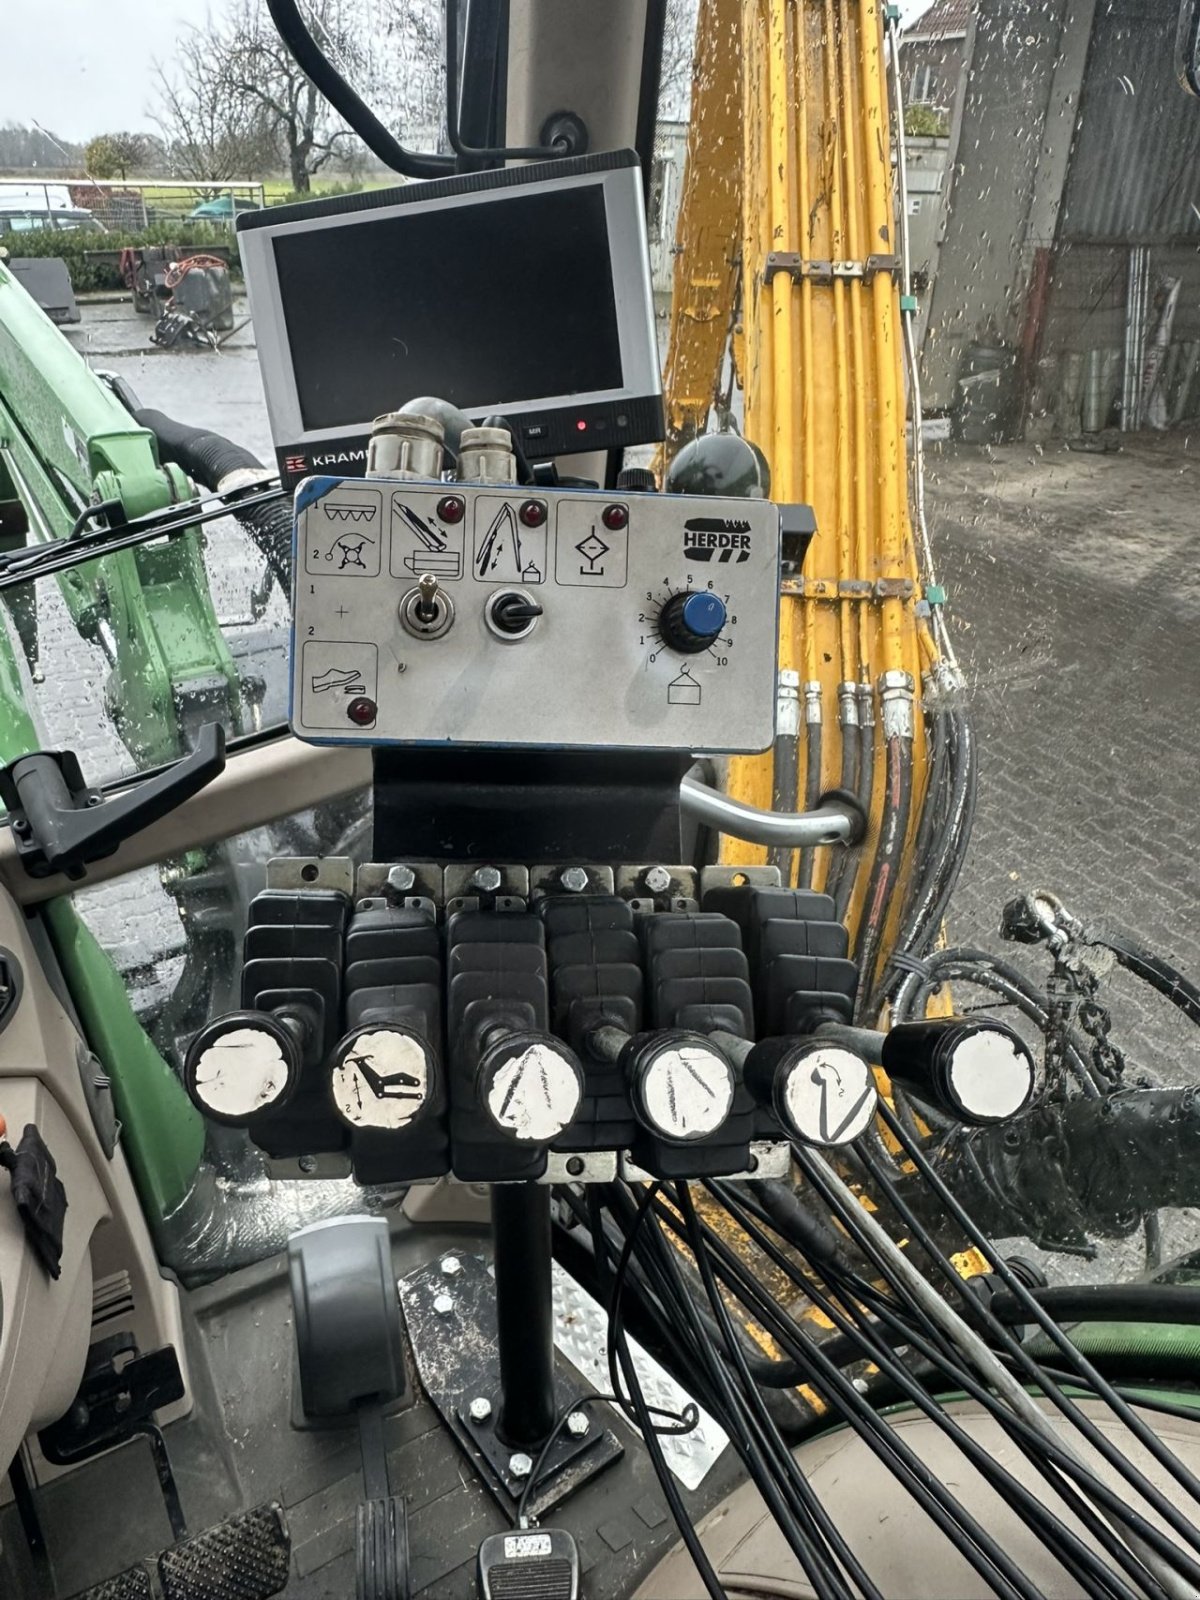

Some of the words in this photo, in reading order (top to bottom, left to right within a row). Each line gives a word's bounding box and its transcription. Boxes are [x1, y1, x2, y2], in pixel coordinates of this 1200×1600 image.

[684, 532, 751, 550] HERDER
[313, 549, 320, 559] 2
[663, 577, 669, 586] 4
[687, 574, 693, 583] 5
[707, 580, 714, 589] 6
[310, 585, 315, 594] 1
[646, 592, 652, 601] 3
[724, 595, 730, 604] 7
[638, 613, 645, 622] 2
[731, 615, 737, 624] 8
[308, 626, 315, 635] 2
[640, 636, 644, 645] 1
[727, 639, 733, 648] 9
[649, 654, 656, 663] 0
[716, 657, 728, 666] 10
